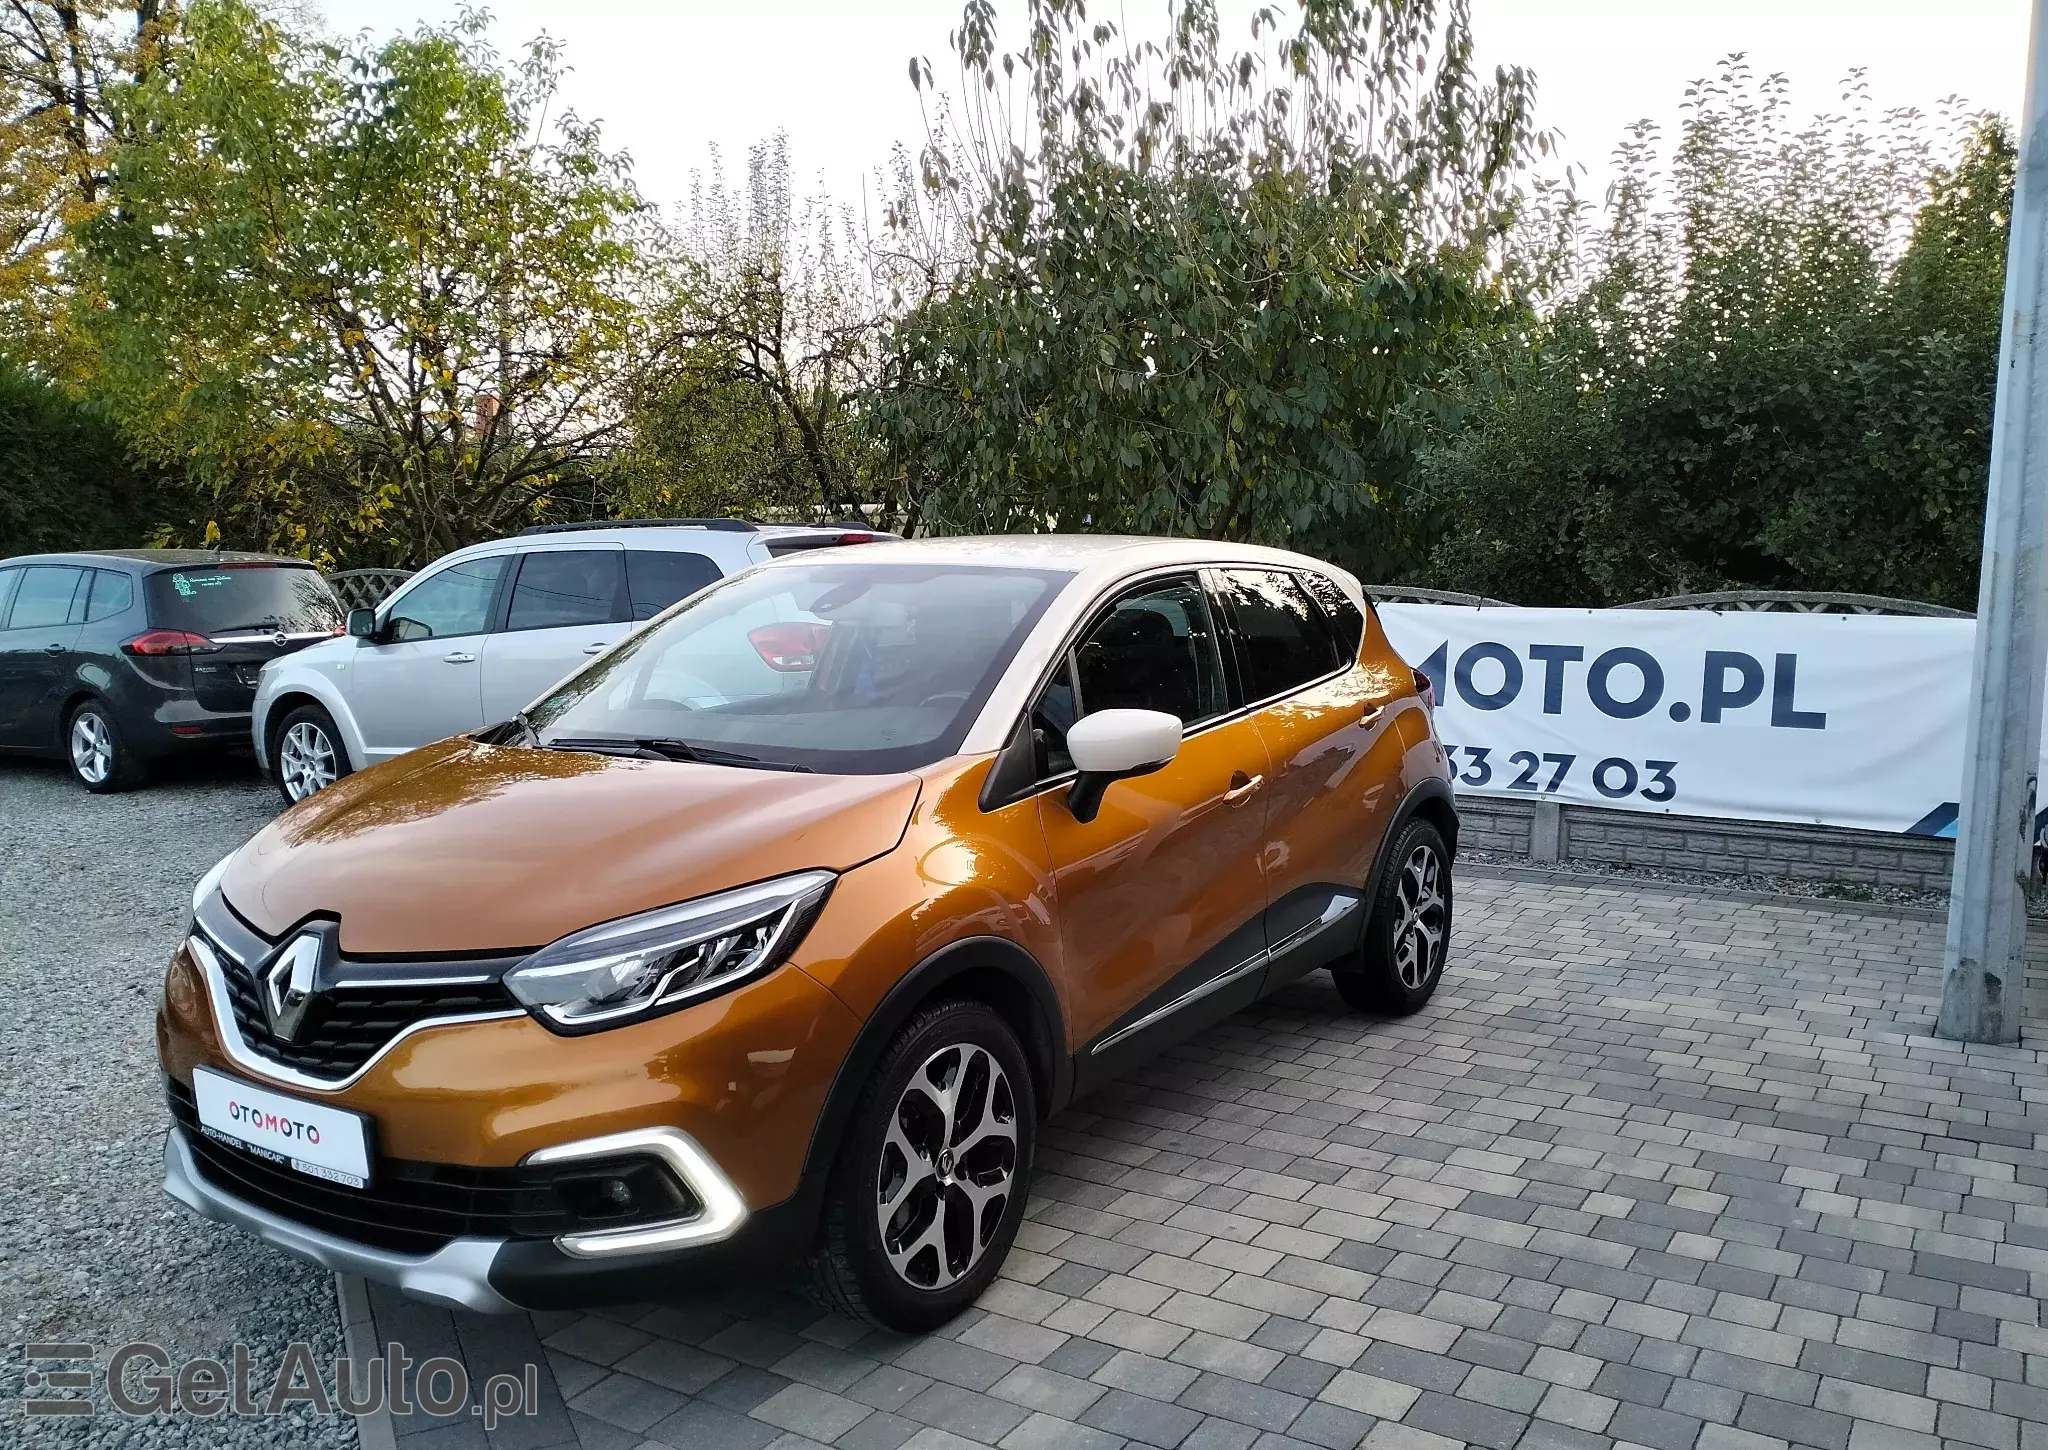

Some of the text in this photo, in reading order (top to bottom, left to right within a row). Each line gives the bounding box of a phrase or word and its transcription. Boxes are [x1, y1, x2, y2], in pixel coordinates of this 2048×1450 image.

[1506, 750, 1577, 793] 27
[1592, 757, 1679, 803] 03
[201, 1125, 244, 1150] AUTO-HANDEL
[229, 1101, 320, 1145] OTOMOTO
[302, 1163, 360, 1187] 501 332 703
